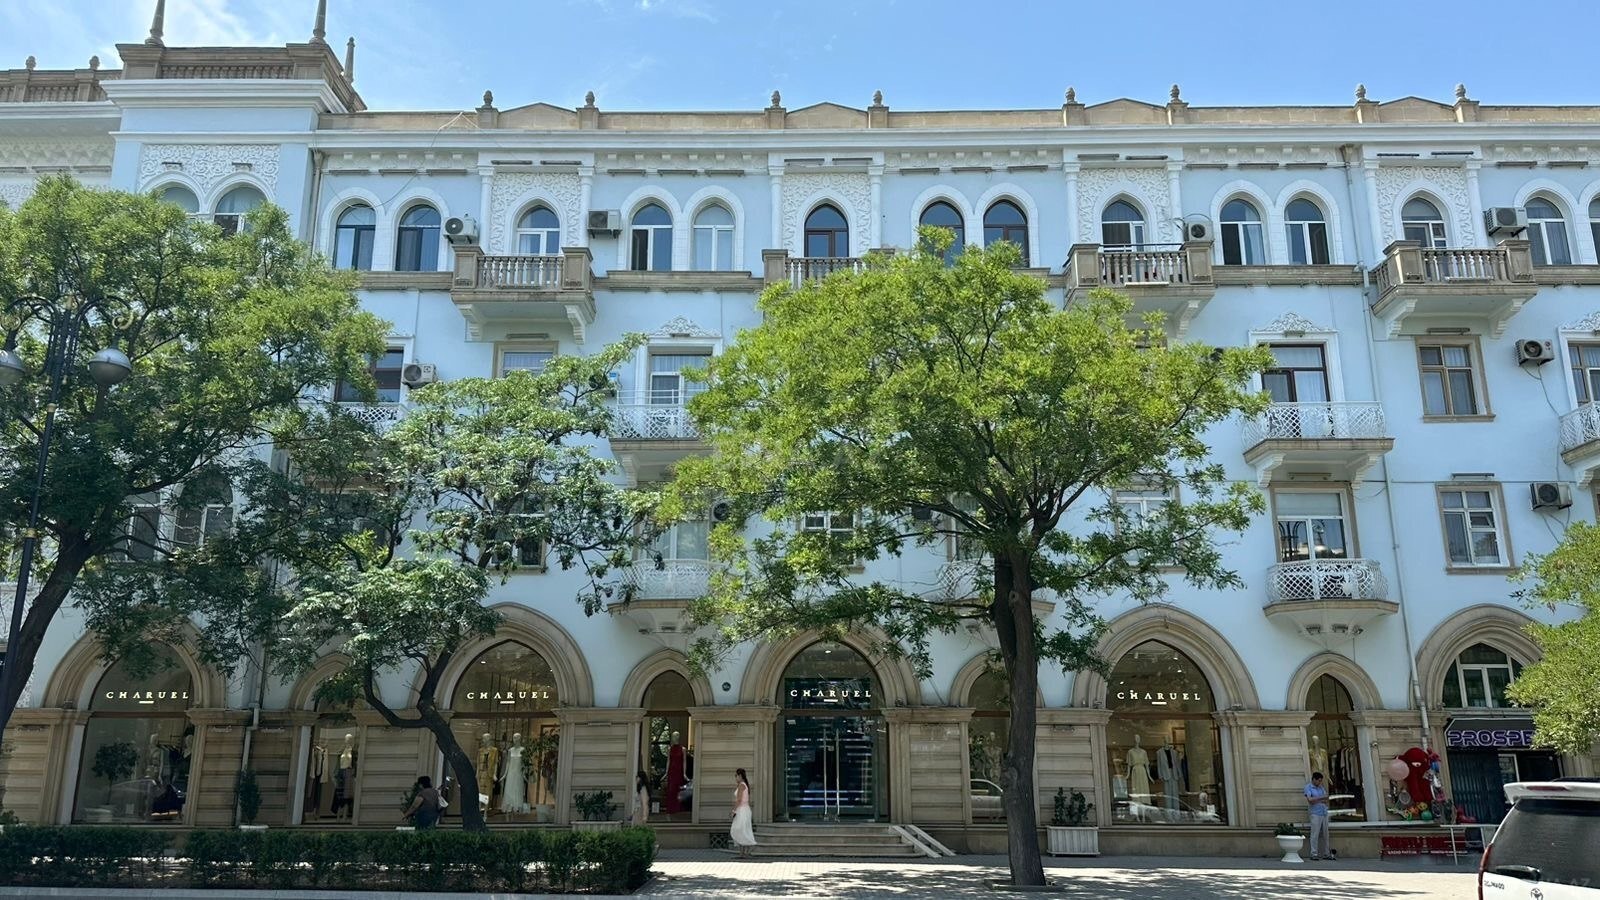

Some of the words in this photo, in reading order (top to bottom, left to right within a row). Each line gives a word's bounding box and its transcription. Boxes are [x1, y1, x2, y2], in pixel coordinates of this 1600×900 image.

[105, 691, 189, 699] CHARUEL
[466, 691, 550, 700] CHARUEL
[790, 689, 872, 698] CHARUEL
[1116, 692, 1201, 701] CHARUEL
[1447, 729, 1535, 747] PROSPE
